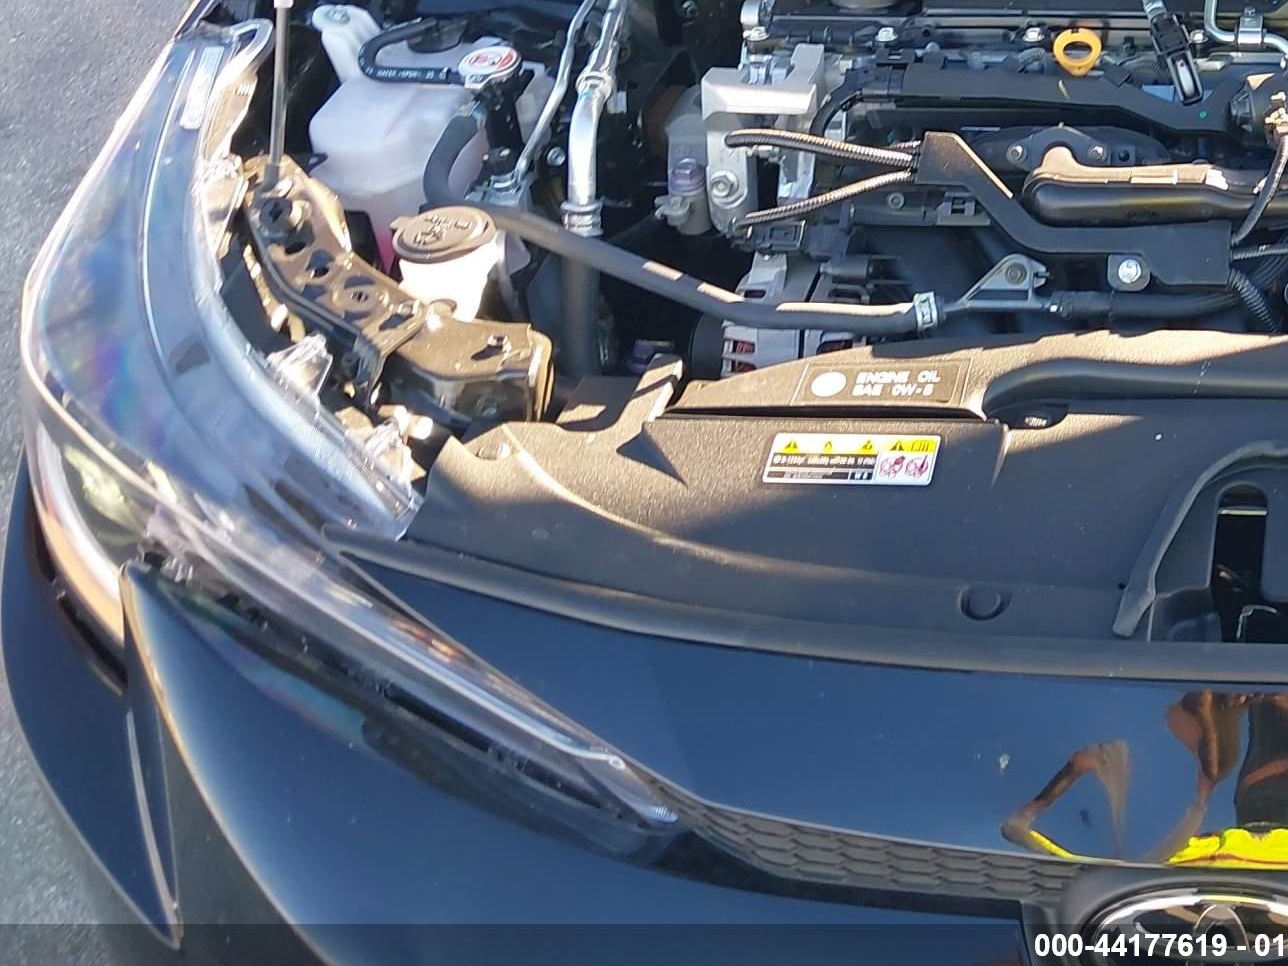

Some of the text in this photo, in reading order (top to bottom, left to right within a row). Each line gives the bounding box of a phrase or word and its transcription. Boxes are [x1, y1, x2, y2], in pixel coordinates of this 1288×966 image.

[855, 369, 941, 384] ENGINE OIL
[851, 383, 884, 397] SAE
